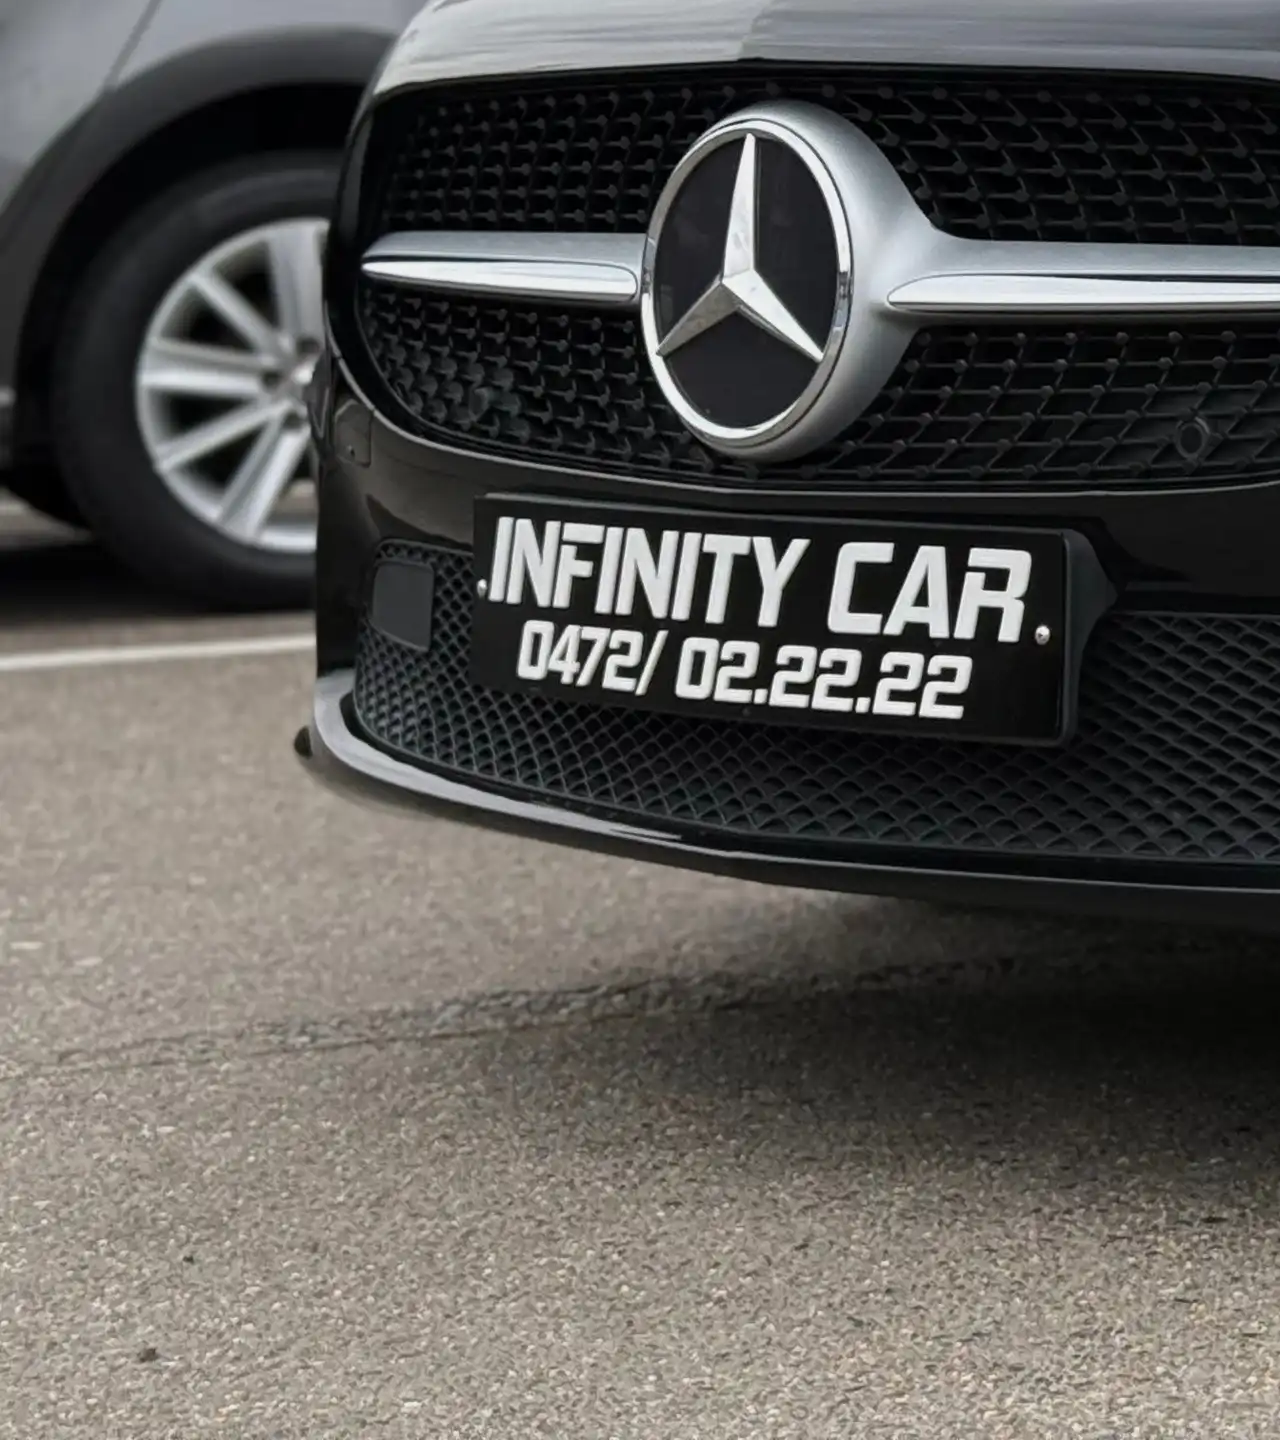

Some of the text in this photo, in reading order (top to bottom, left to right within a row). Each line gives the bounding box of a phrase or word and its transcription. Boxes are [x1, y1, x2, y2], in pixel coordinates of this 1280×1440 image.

[487, 516, 811, 628] INFINITY
[516, 618, 973, 720] 0472/ 02.22.22
